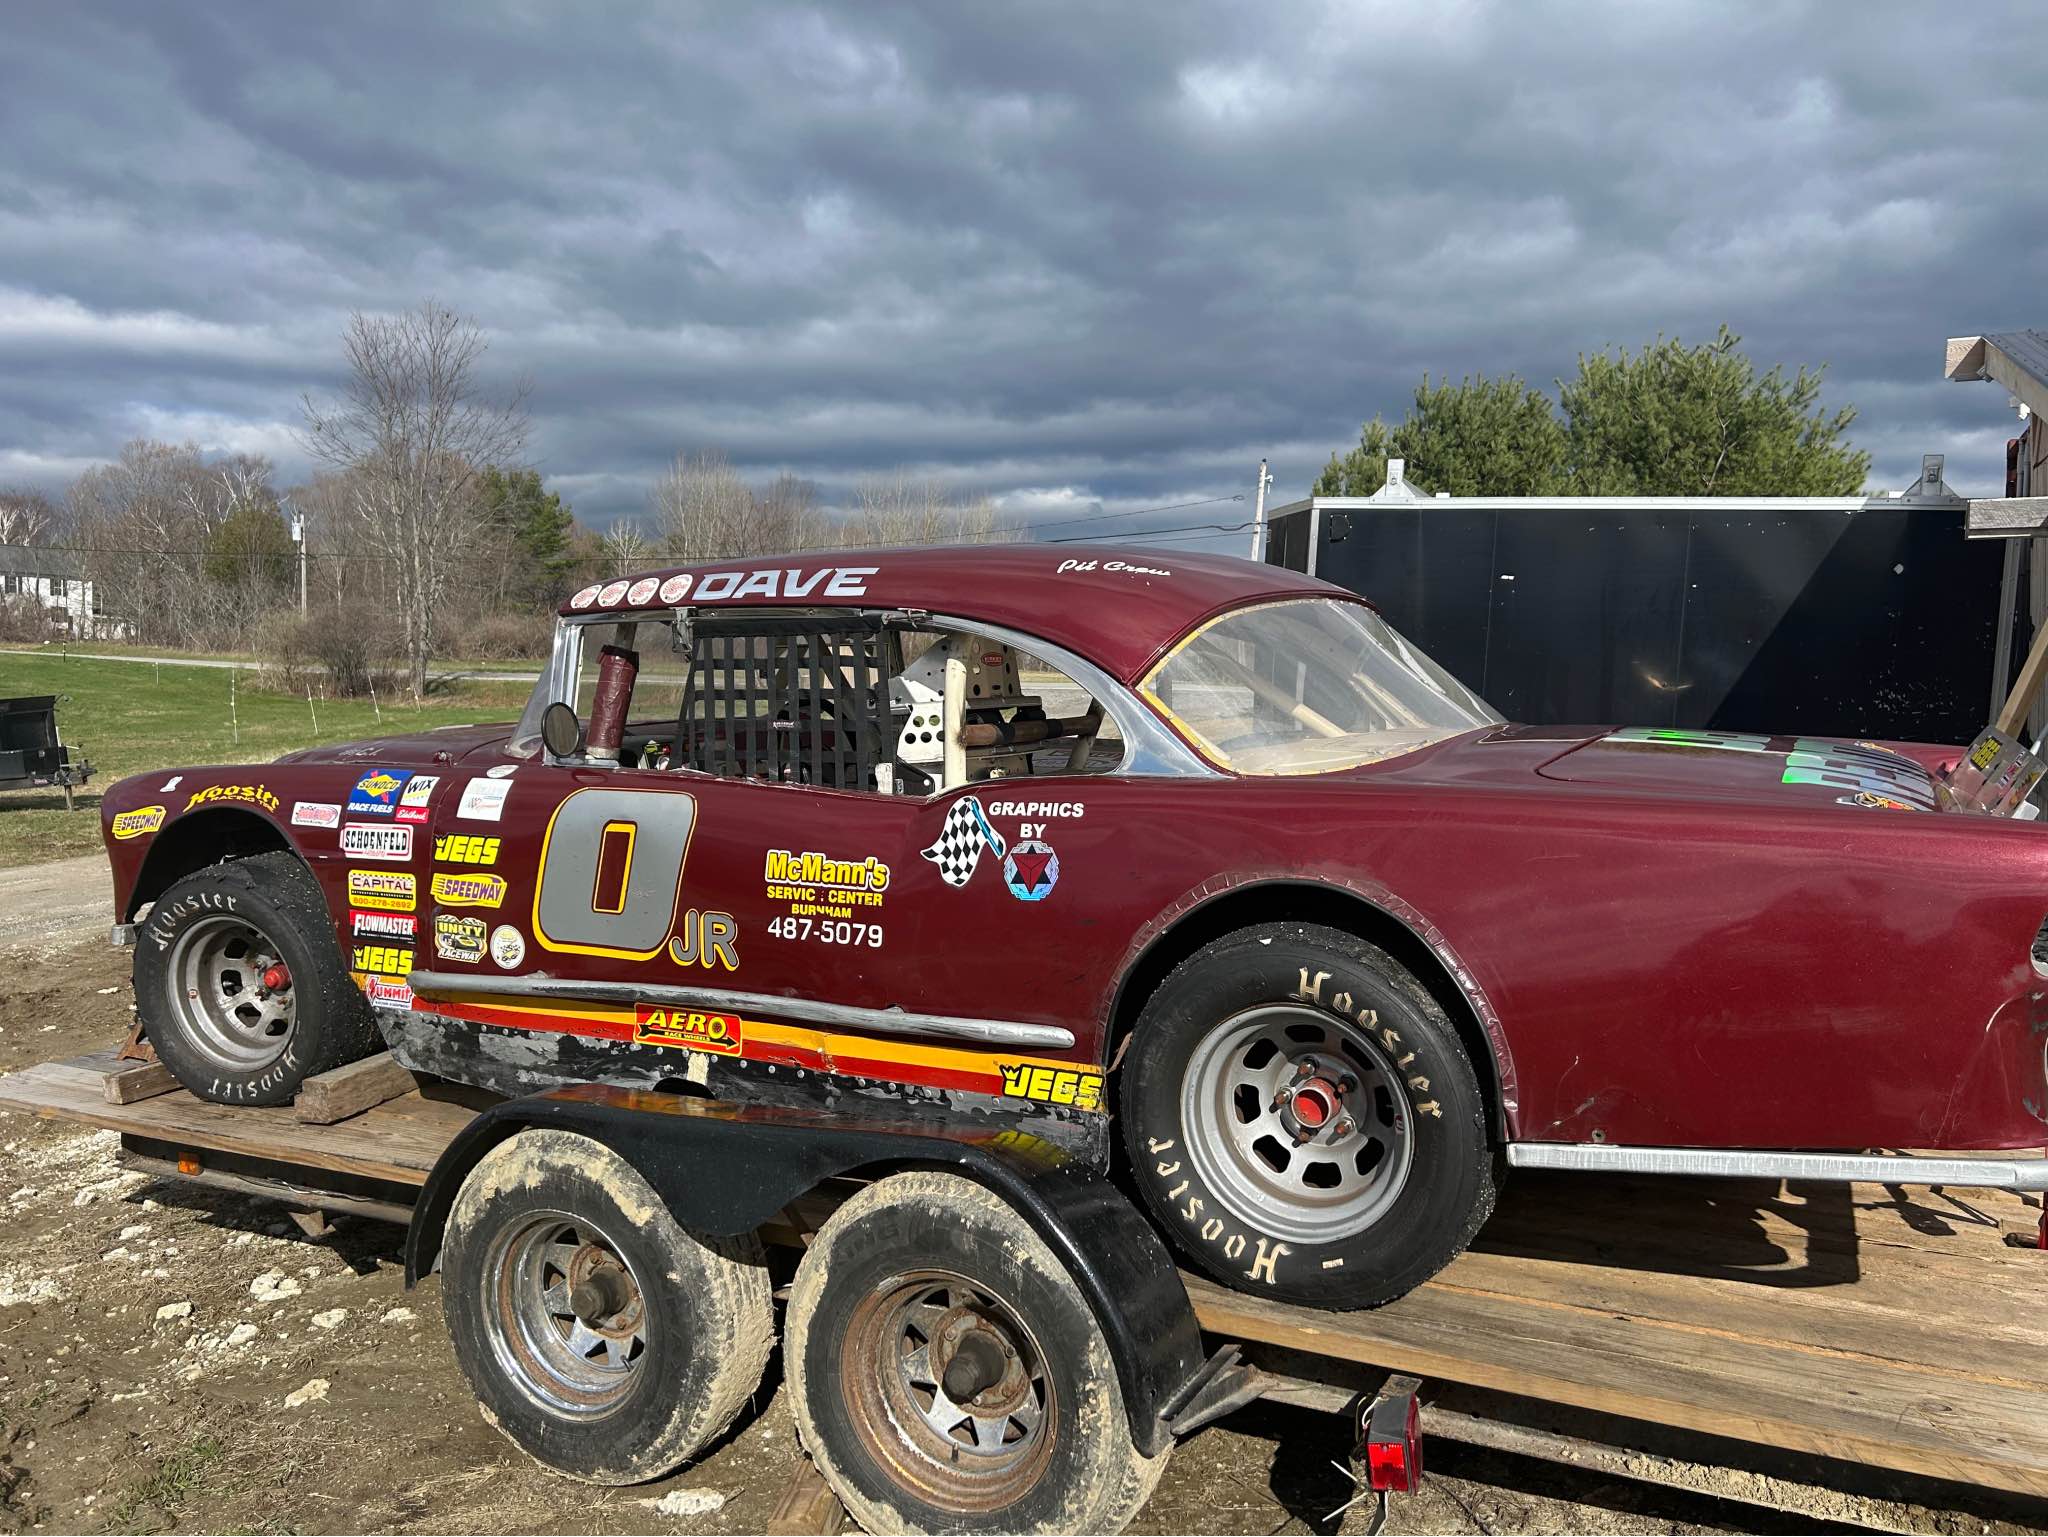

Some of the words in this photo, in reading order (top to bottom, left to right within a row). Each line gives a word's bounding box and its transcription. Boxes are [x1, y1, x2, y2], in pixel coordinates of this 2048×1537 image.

[1056, 559, 1098, 574] Pit
[1102, 561, 1171, 576] Crew
[691, 567, 880, 601] DAVE
[358, 780, 400, 790] SUNOCO
[407, 779, 436, 794] WIX
[183, 784, 280, 813] Hoosier
[347, 802, 371, 812] RACE
[369, 803, 395, 814] FUELS
[988, 801, 1085, 818] GRAPHICS
[121, 812, 161, 831] SPEEDWAY
[1020, 823, 1047, 839] BY
[344, 829, 408, 851] SCHOENFELD
[434, 834, 501, 866] JEGS
[531, 786, 698, 962] 0
[668, 908, 740, 972] JR
[766, 850, 890, 890] McMann's
[352, 876, 413, 891] CAPITAL
[444, 878, 501, 902] SPEEDWAY
[766, 885, 825, 903] SERVIC
[828, 889, 883, 907] CENTER
[150, 892, 237, 951] Hoosier
[791, 903, 852, 919] BURNHAM
[353, 913, 414, 936] FLOWMASTER
[438, 921, 483, 938] UNITY
[767, 916, 883, 948] 487-5079
[353, 945, 414, 975] JEGS
[440, 947, 480, 962] RACEWAY
[646, 1009, 727, 1040] AERO
[1298, 966, 1443, 1120] Hoosier
[1002, 1066, 1104, 1109] JEGS
[1147, 1136, 1292, 1286] Hoosier
